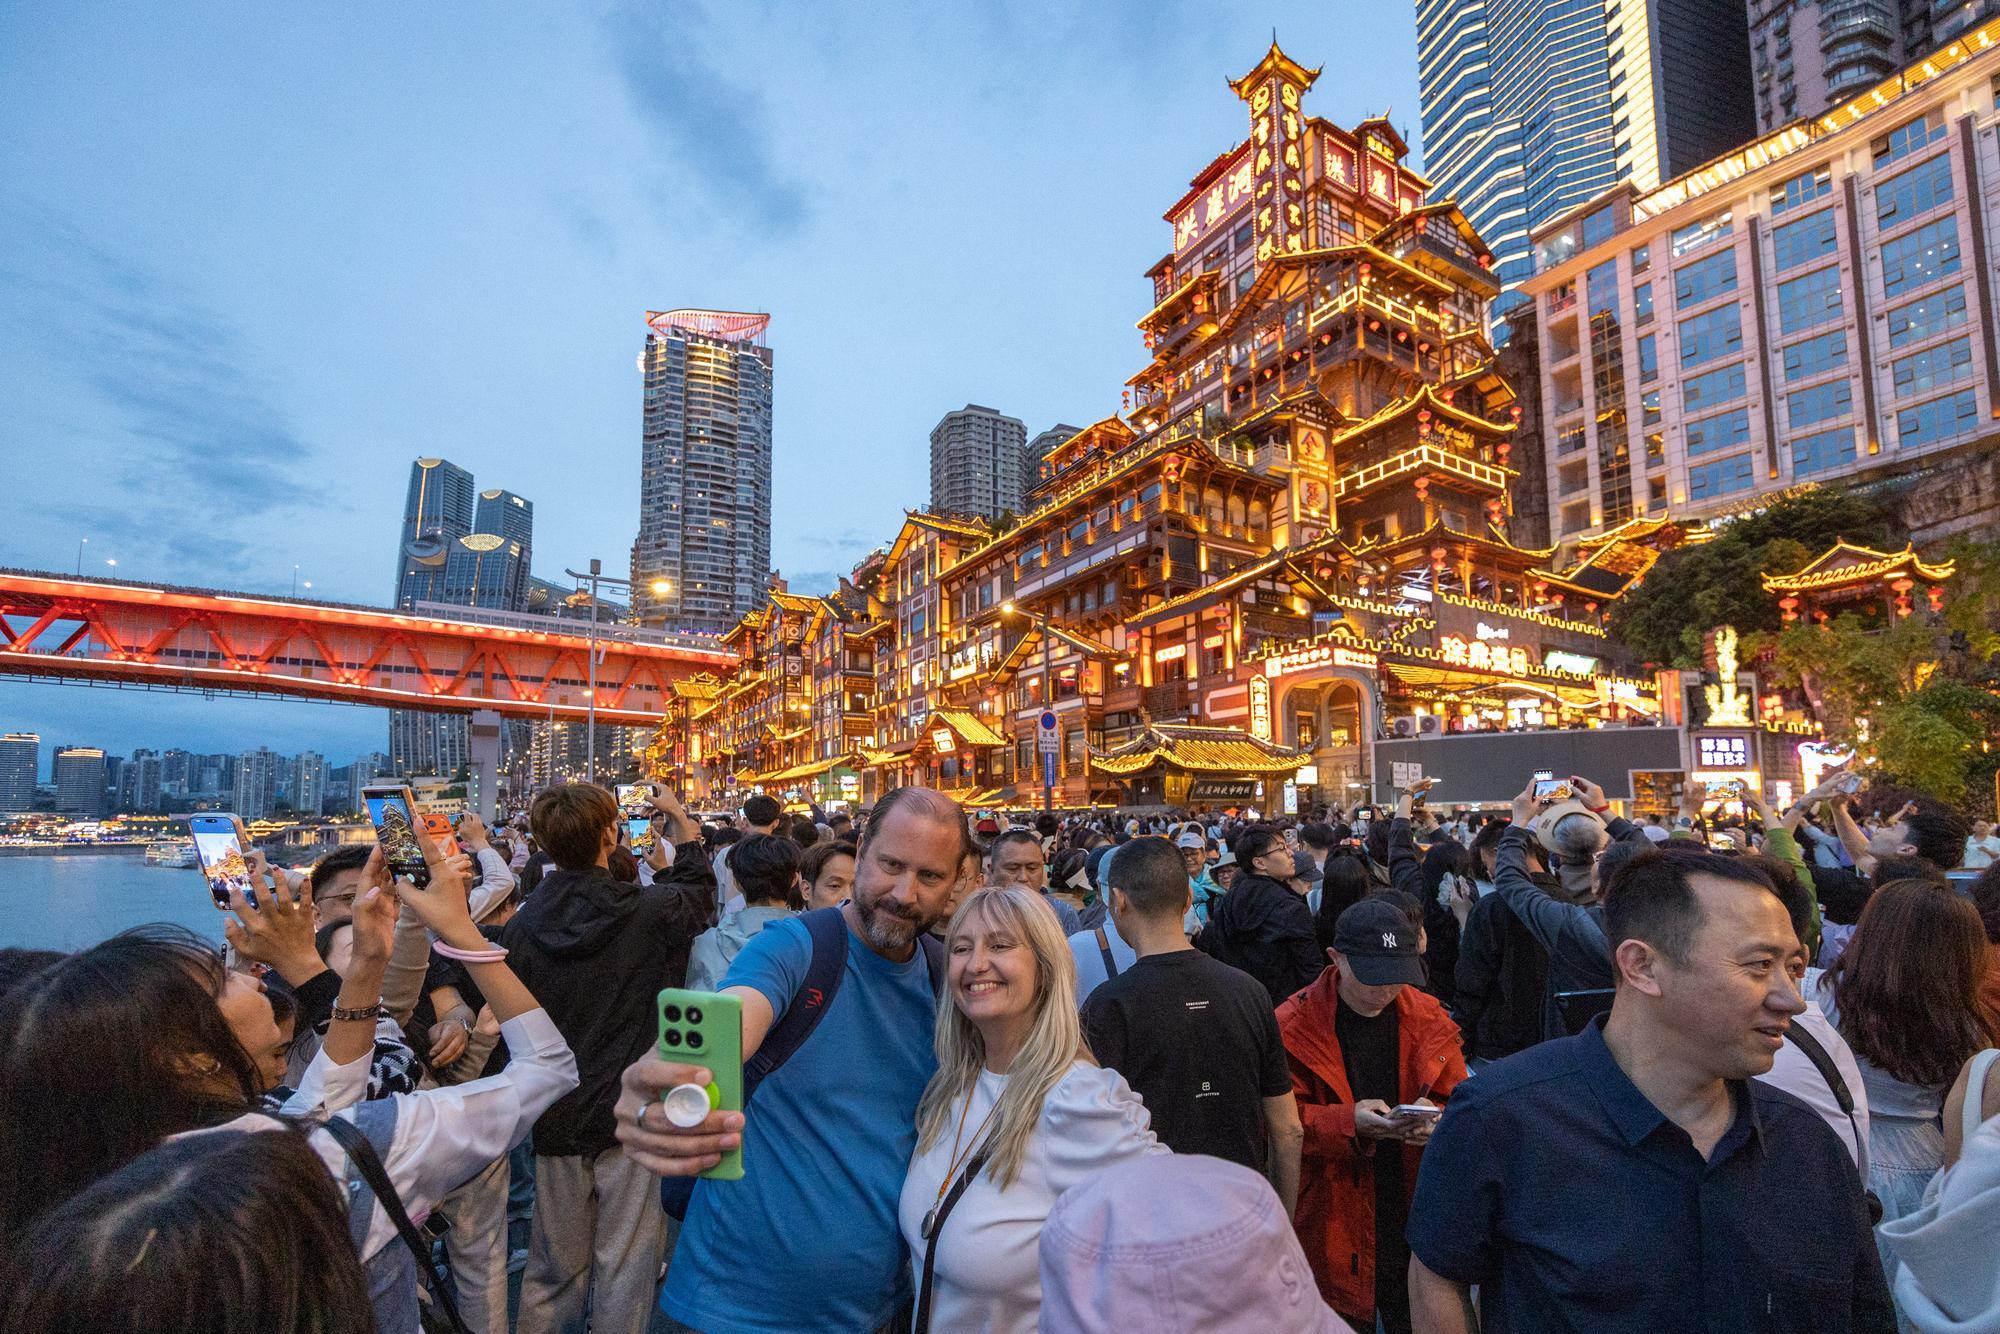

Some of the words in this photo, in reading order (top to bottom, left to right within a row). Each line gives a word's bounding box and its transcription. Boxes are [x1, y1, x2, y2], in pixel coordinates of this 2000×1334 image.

[1176, 161, 1252, 251] 洪崖洞
[1382, 932, 1397, 948] NY
